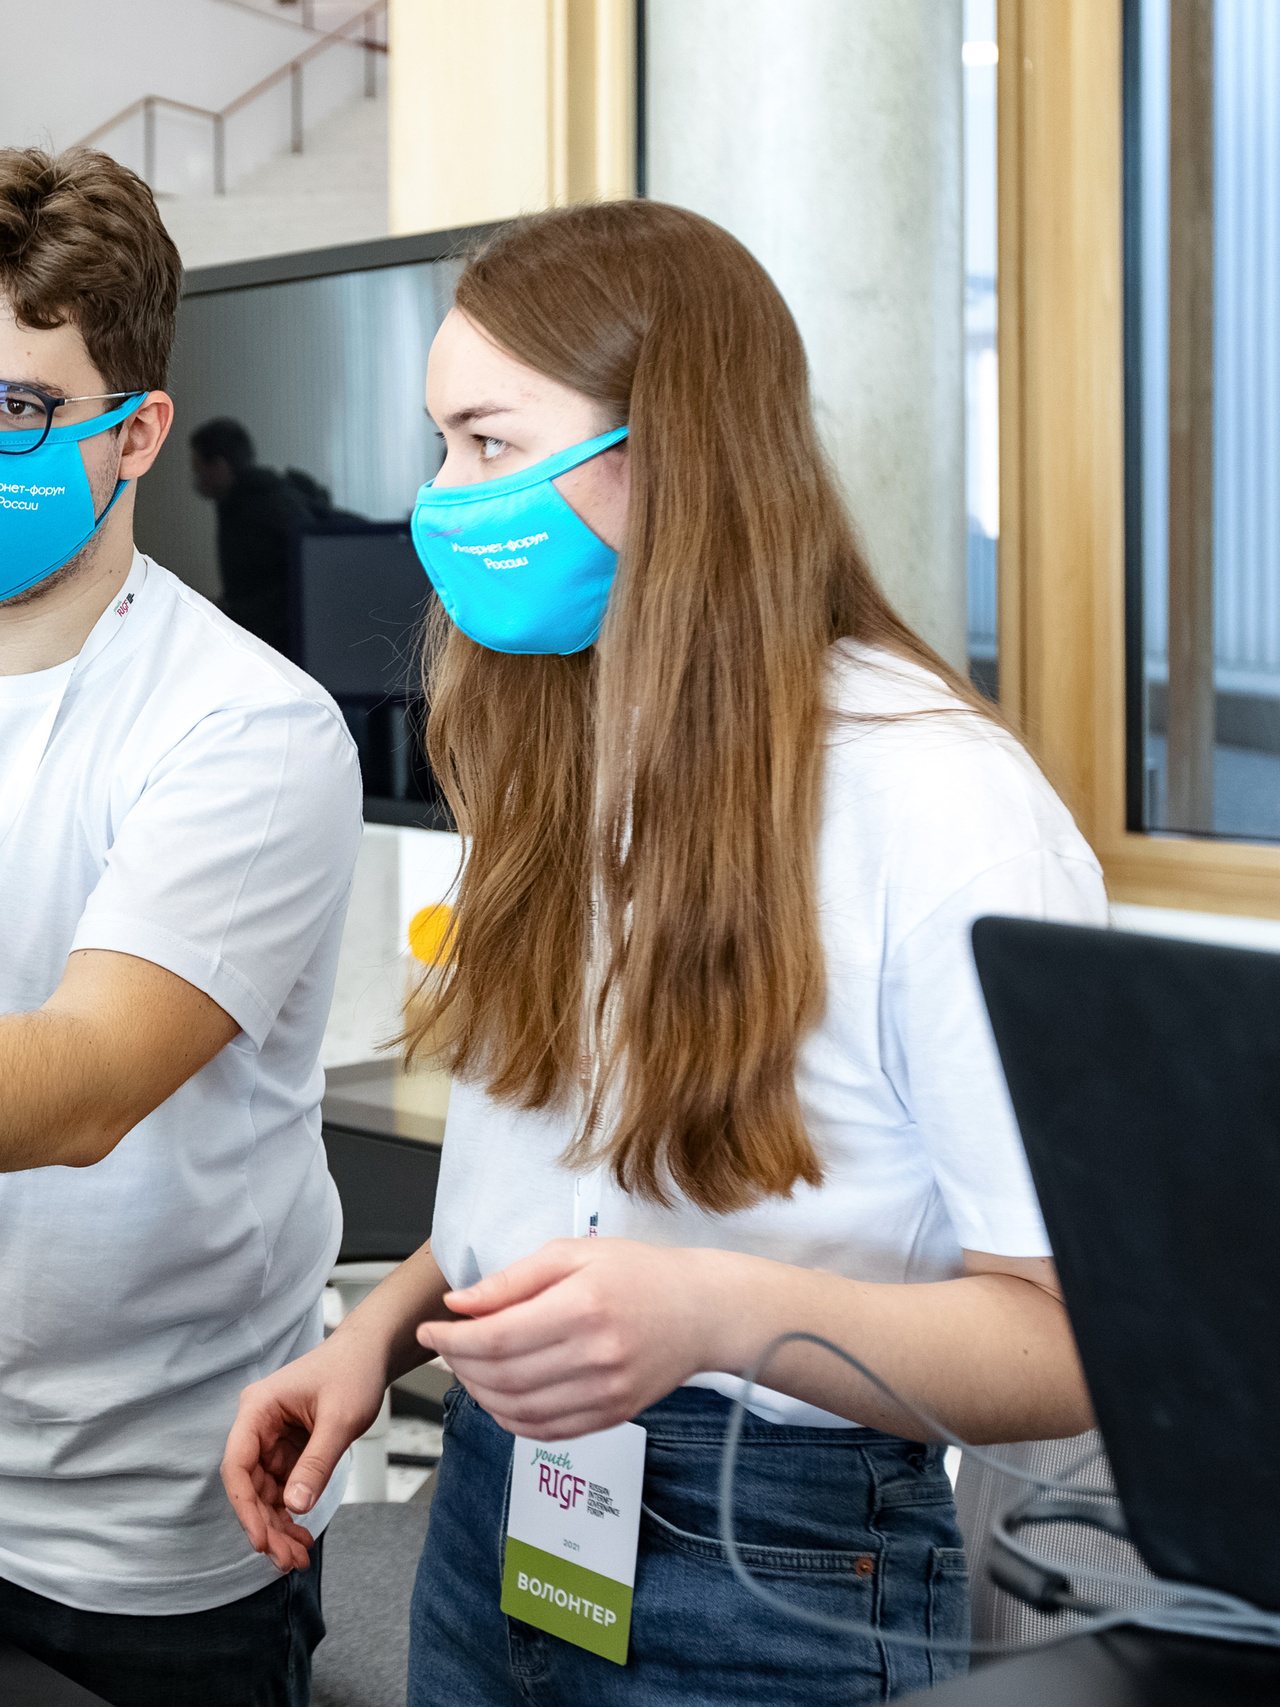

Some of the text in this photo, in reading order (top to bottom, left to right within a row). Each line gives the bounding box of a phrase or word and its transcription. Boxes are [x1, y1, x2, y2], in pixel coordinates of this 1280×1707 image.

[531, 1448, 573, 1470] youth
[539, 1463, 586, 1510] RIGF
[563, 1538, 580, 1551] 2021
[517, 1571, 617, 1627] ВОЛОНТЕР
